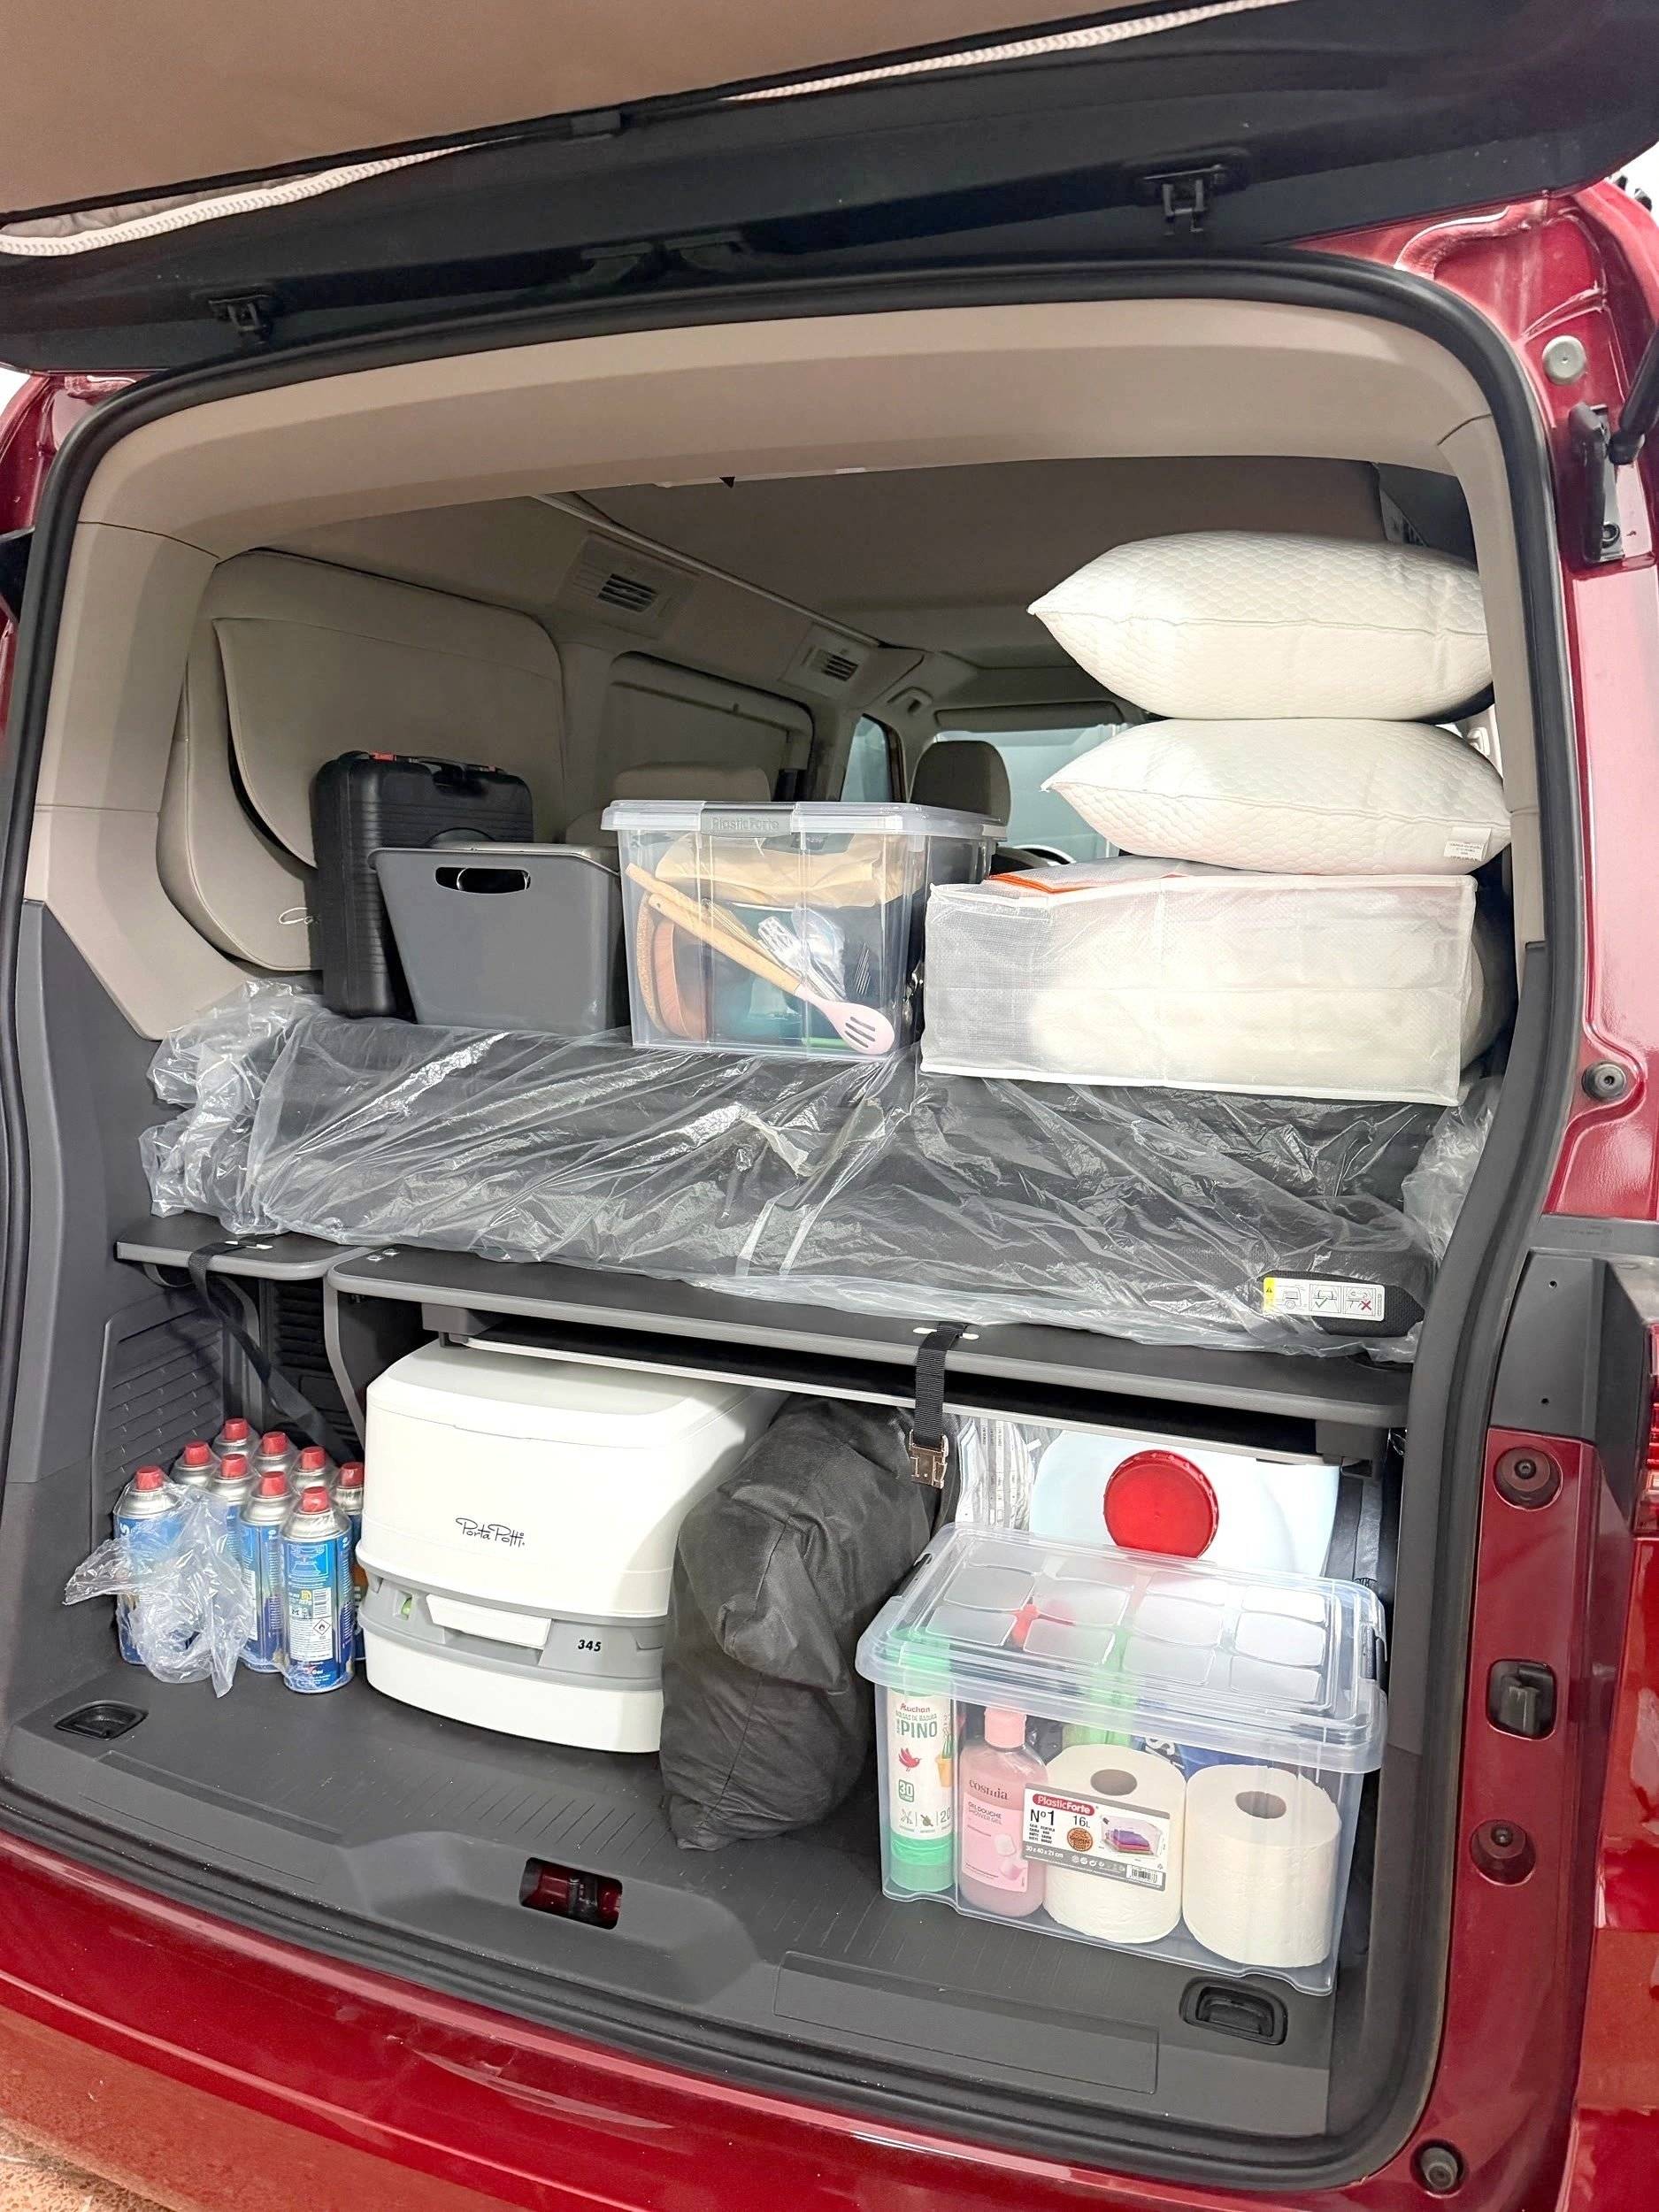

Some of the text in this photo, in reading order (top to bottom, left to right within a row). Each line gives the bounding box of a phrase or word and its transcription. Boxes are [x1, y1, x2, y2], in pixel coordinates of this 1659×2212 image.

[710, 817, 780, 831] PlasticForte
[456, 1517, 490, 1540] Porta
[577, 1639, 602, 1652] 345
[900, 1702, 931, 1713] Auchan
[901, 1719, 938, 1739] PINO
[899, 1780, 914, 1797] 30
[969, 1779, 1009, 1801] cosmia
[976, 1807, 1002, 1820] DOUCHE
[1037, 1795, 1091, 1815] PlasticForte
[940, 1807, 951, 1824] 20
